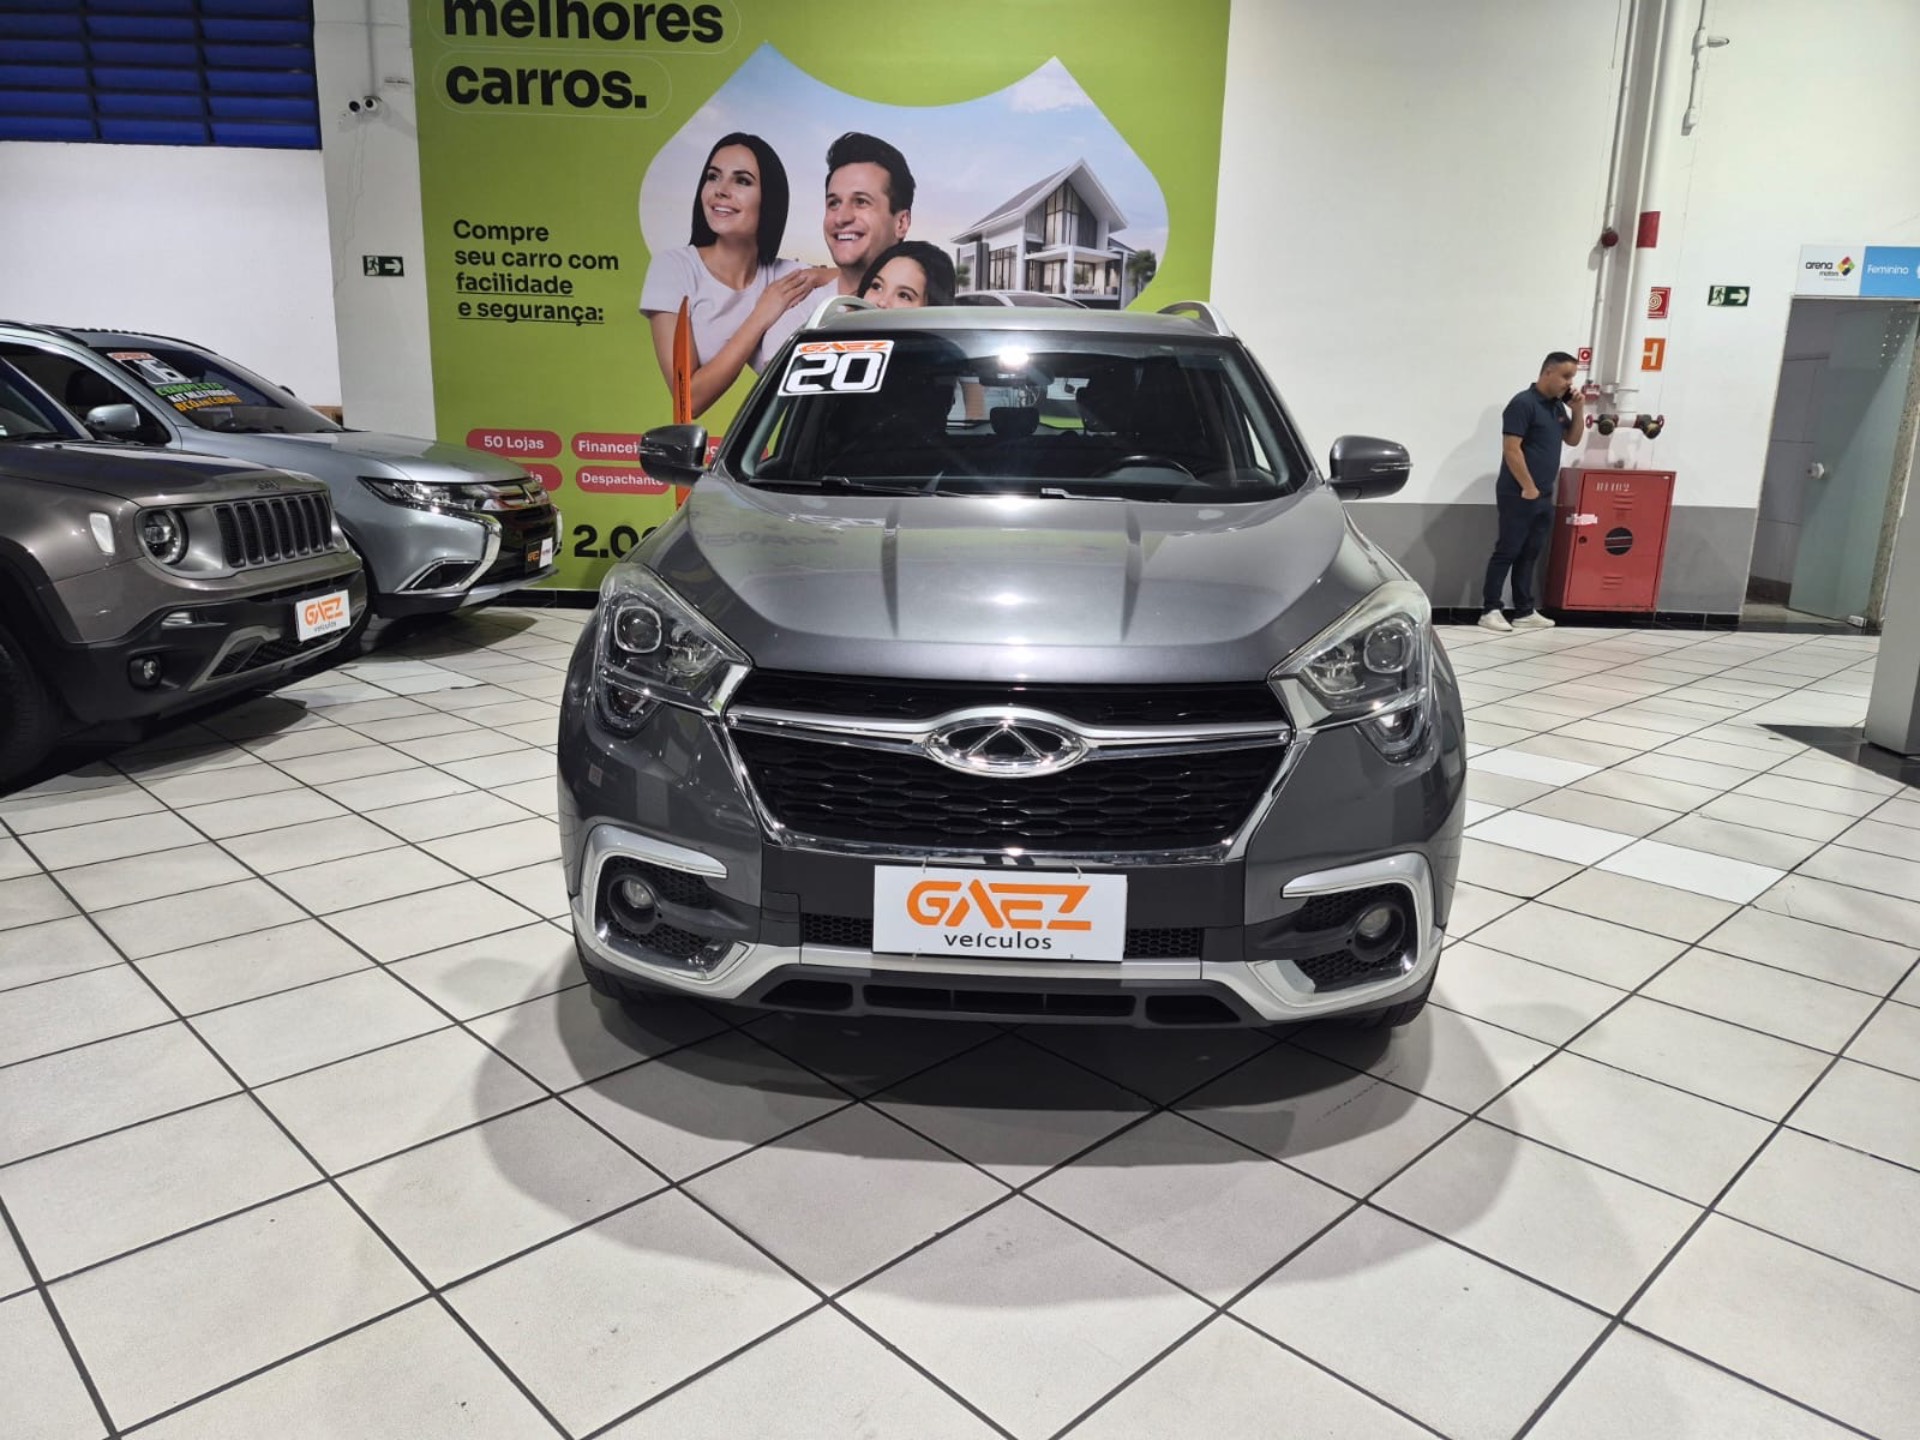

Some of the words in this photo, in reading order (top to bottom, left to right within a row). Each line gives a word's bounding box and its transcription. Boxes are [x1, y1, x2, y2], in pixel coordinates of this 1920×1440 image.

[444, 0, 723, 43] melhores
[446, 66, 647, 109] carros.
[453, 219, 549, 245] Compre
[454, 250, 495, 265] seu
[502, 251, 562, 268] carro
[568, 254, 619, 270] com
[1805, 262, 1833, 270] arena
[1867, 264, 1909, 275] Feminino
[456, 272, 573, 294] facilidade
[458, 302, 471, 316] e
[477, 302, 603, 326] segurança:
[785, 352, 883, 393] 20
[484, 436, 503, 448] 50
[507, 437, 544, 451] Lojas
[578, 440, 638, 454] Financei
[573, 524, 658, 558] 2.0
[304, 597, 344, 626] GAEZ
[906, 879, 1091, 931] GAEZ
[944, 931, 1052, 949] veículos
